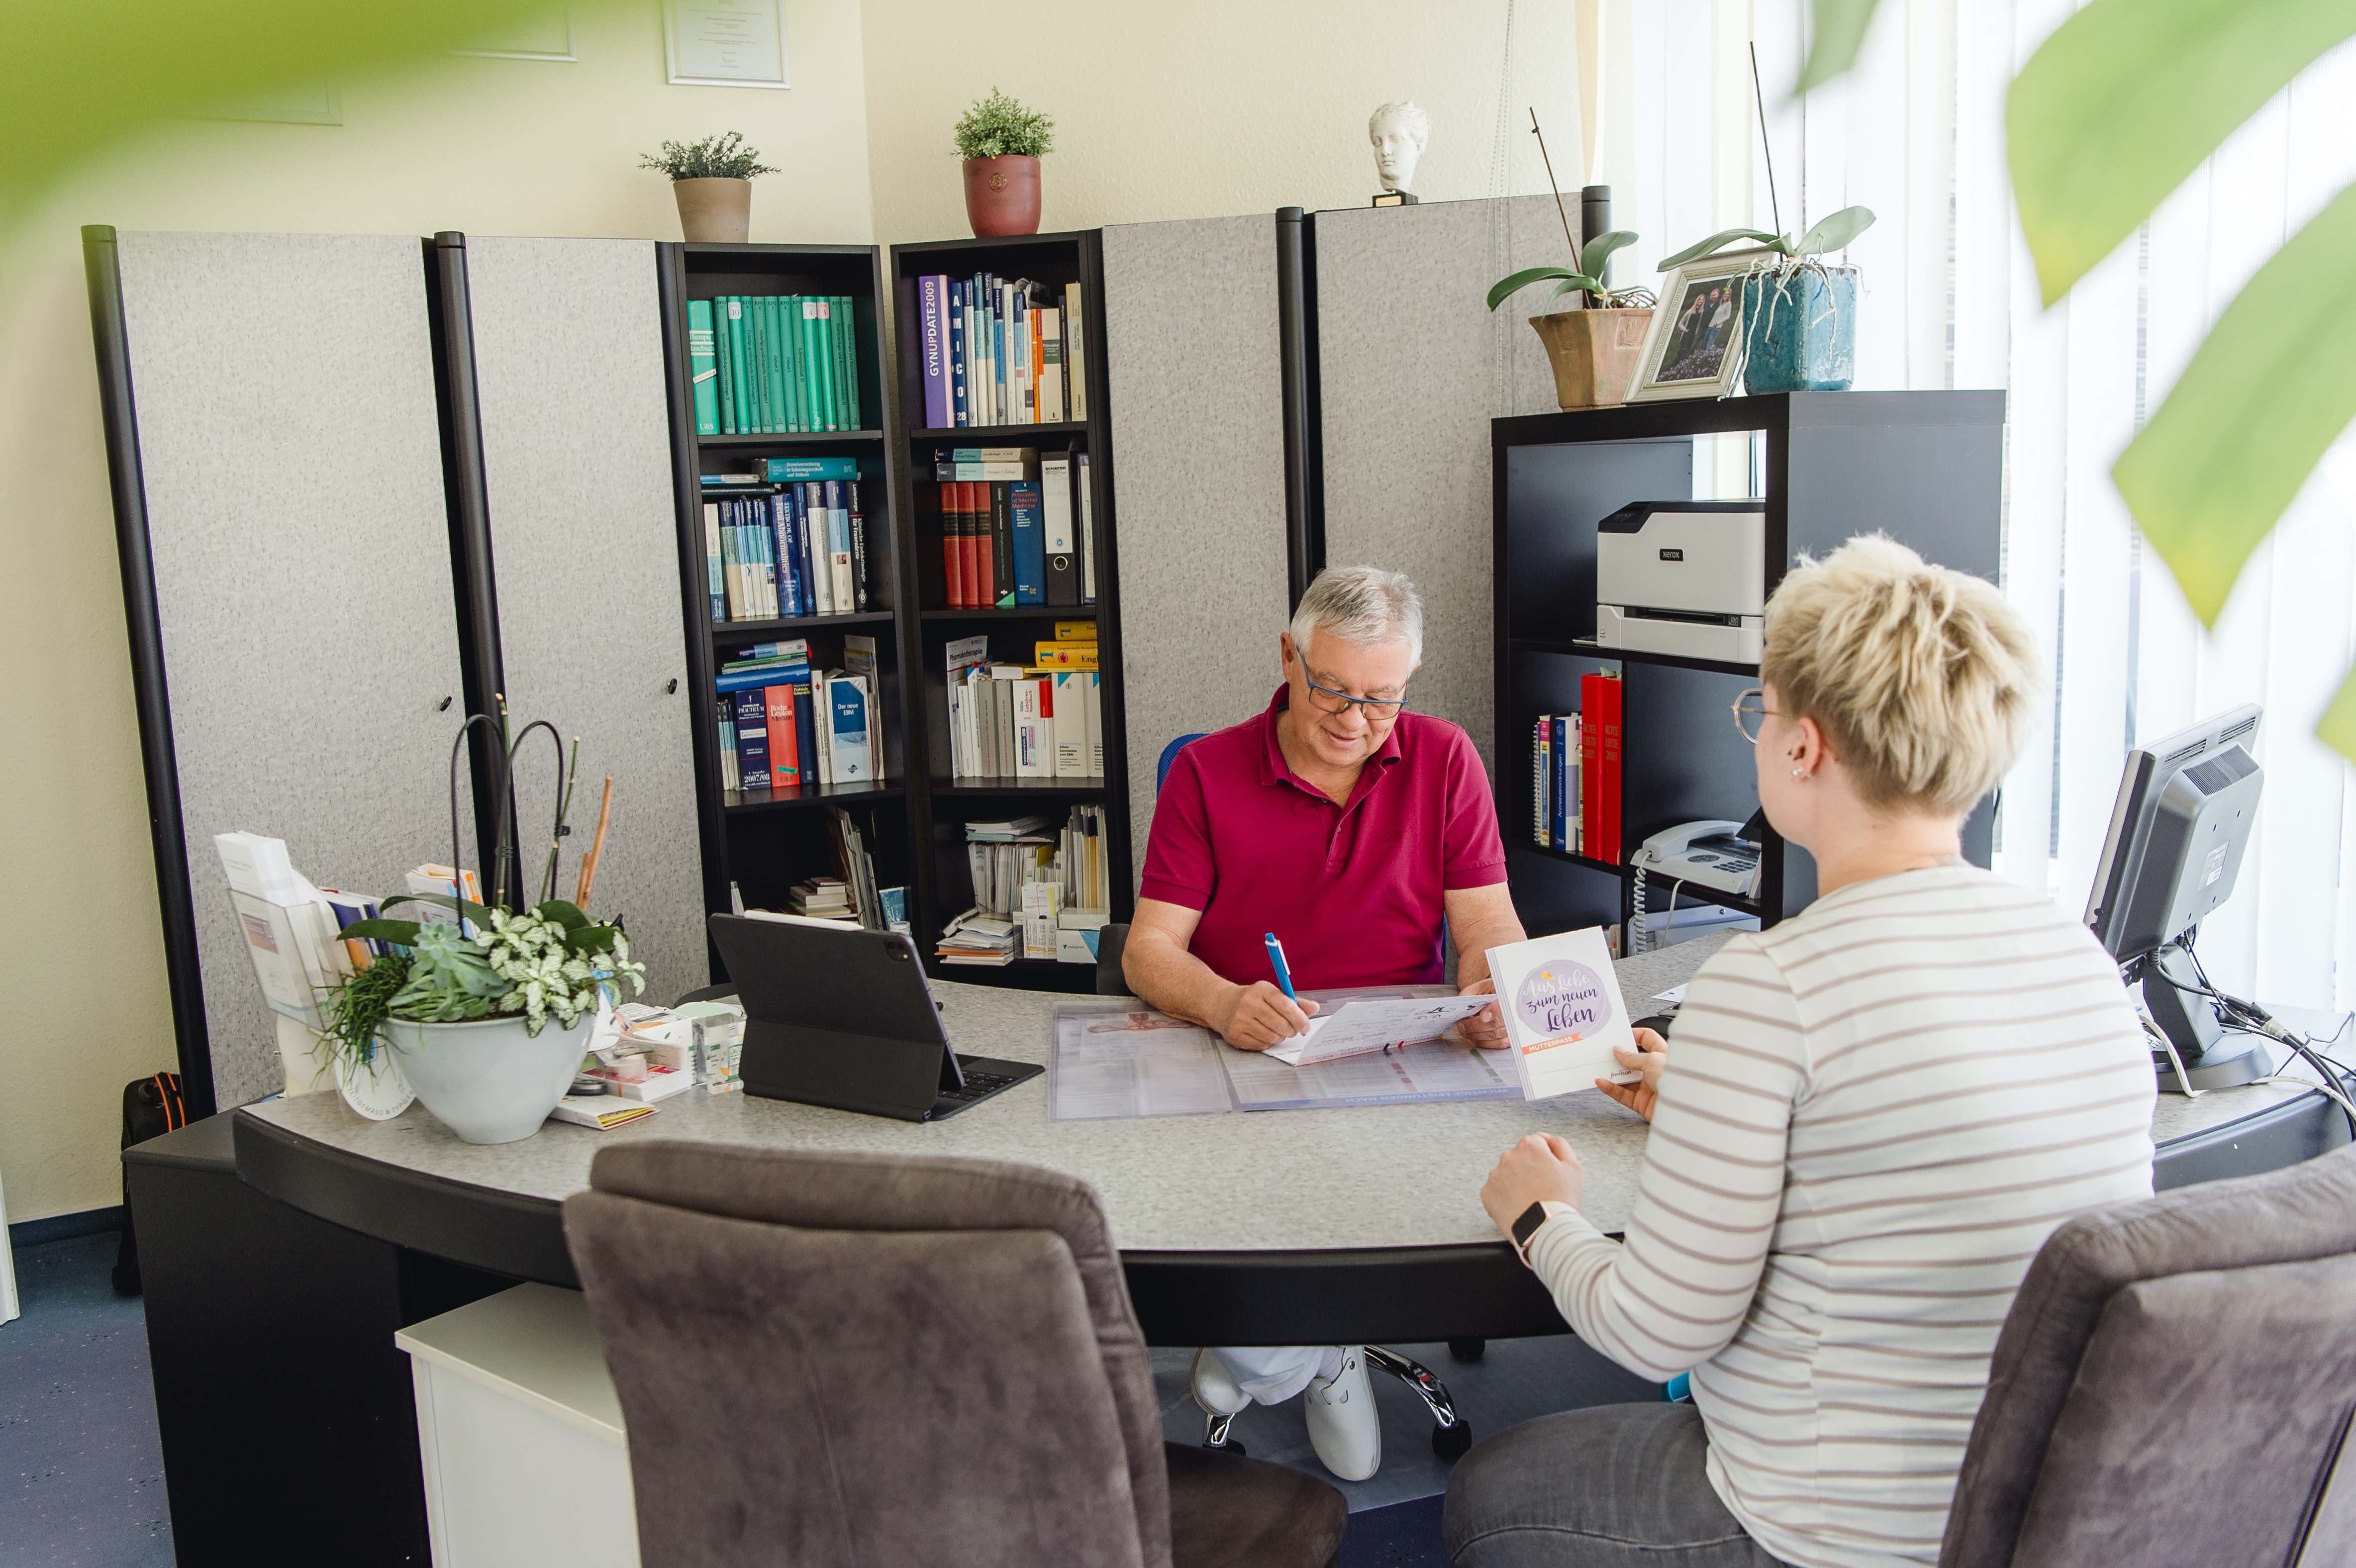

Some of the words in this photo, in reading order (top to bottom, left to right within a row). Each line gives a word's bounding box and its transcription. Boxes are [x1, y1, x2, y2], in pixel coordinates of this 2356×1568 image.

[925, 281, 939, 377] GYNUPDATE2009
[778, 522, 788, 574] Abnormalities
[787, 535, 792, 544] OF
[744, 774, 770, 783] 2007/08
[1523, 978, 1556, 995] Aus
[1557, 969, 1589, 991] Liebe
[1526, 993, 1560, 1014] zum
[1562, 988, 1598, 1003] neuen
[1546, 1002, 1596, 1032] Leben
[1529, 1036, 1573, 1053] MUTTERPASS
